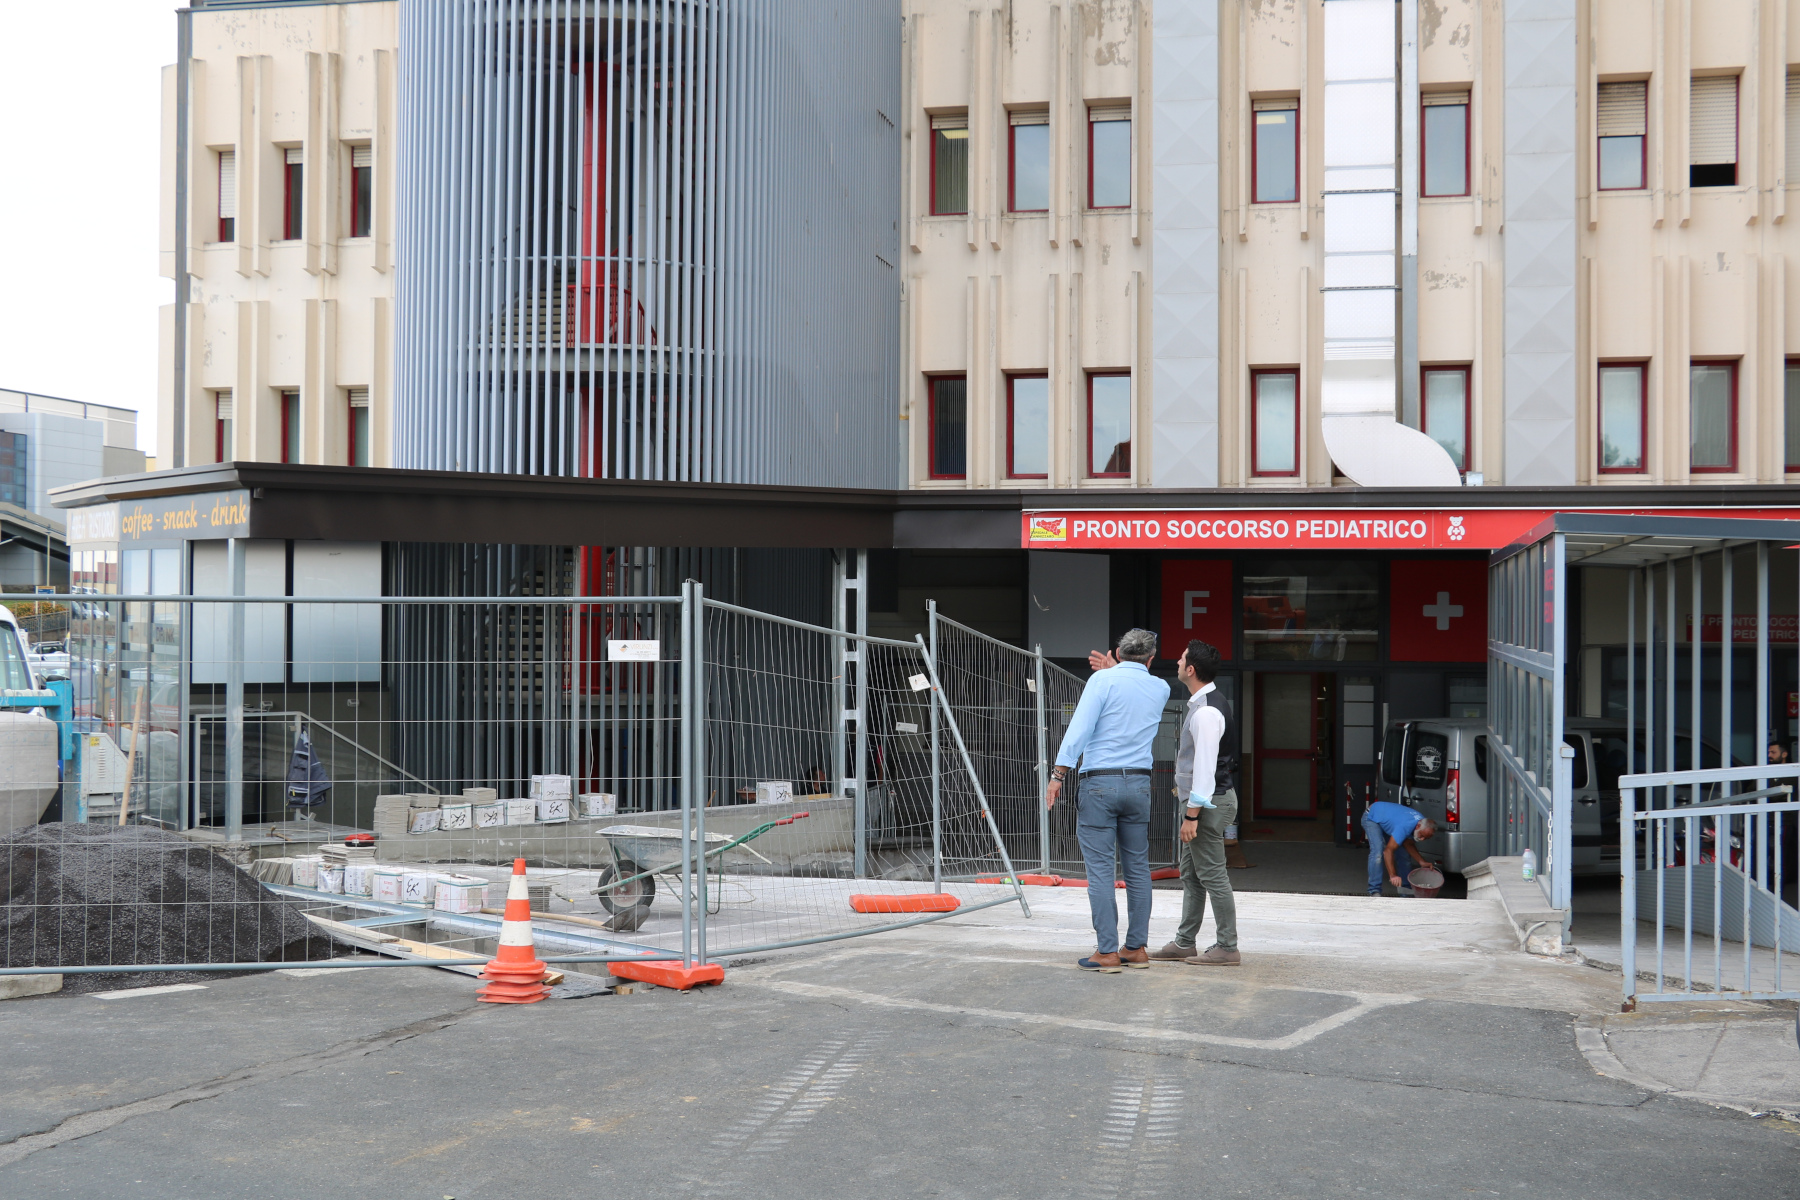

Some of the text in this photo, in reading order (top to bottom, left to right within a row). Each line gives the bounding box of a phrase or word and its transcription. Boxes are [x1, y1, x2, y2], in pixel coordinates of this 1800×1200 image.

[122, 505, 153, 540] coffee
[163, 500, 198, 531] snack
[211, 494, 247, 527] drink
[1073, 519, 1428, 539] PRONTO SOCCORSO PEDIATRICO
[1184, 590, 1210, 629] F
[1708, 616, 1758, 626] PRNTO
